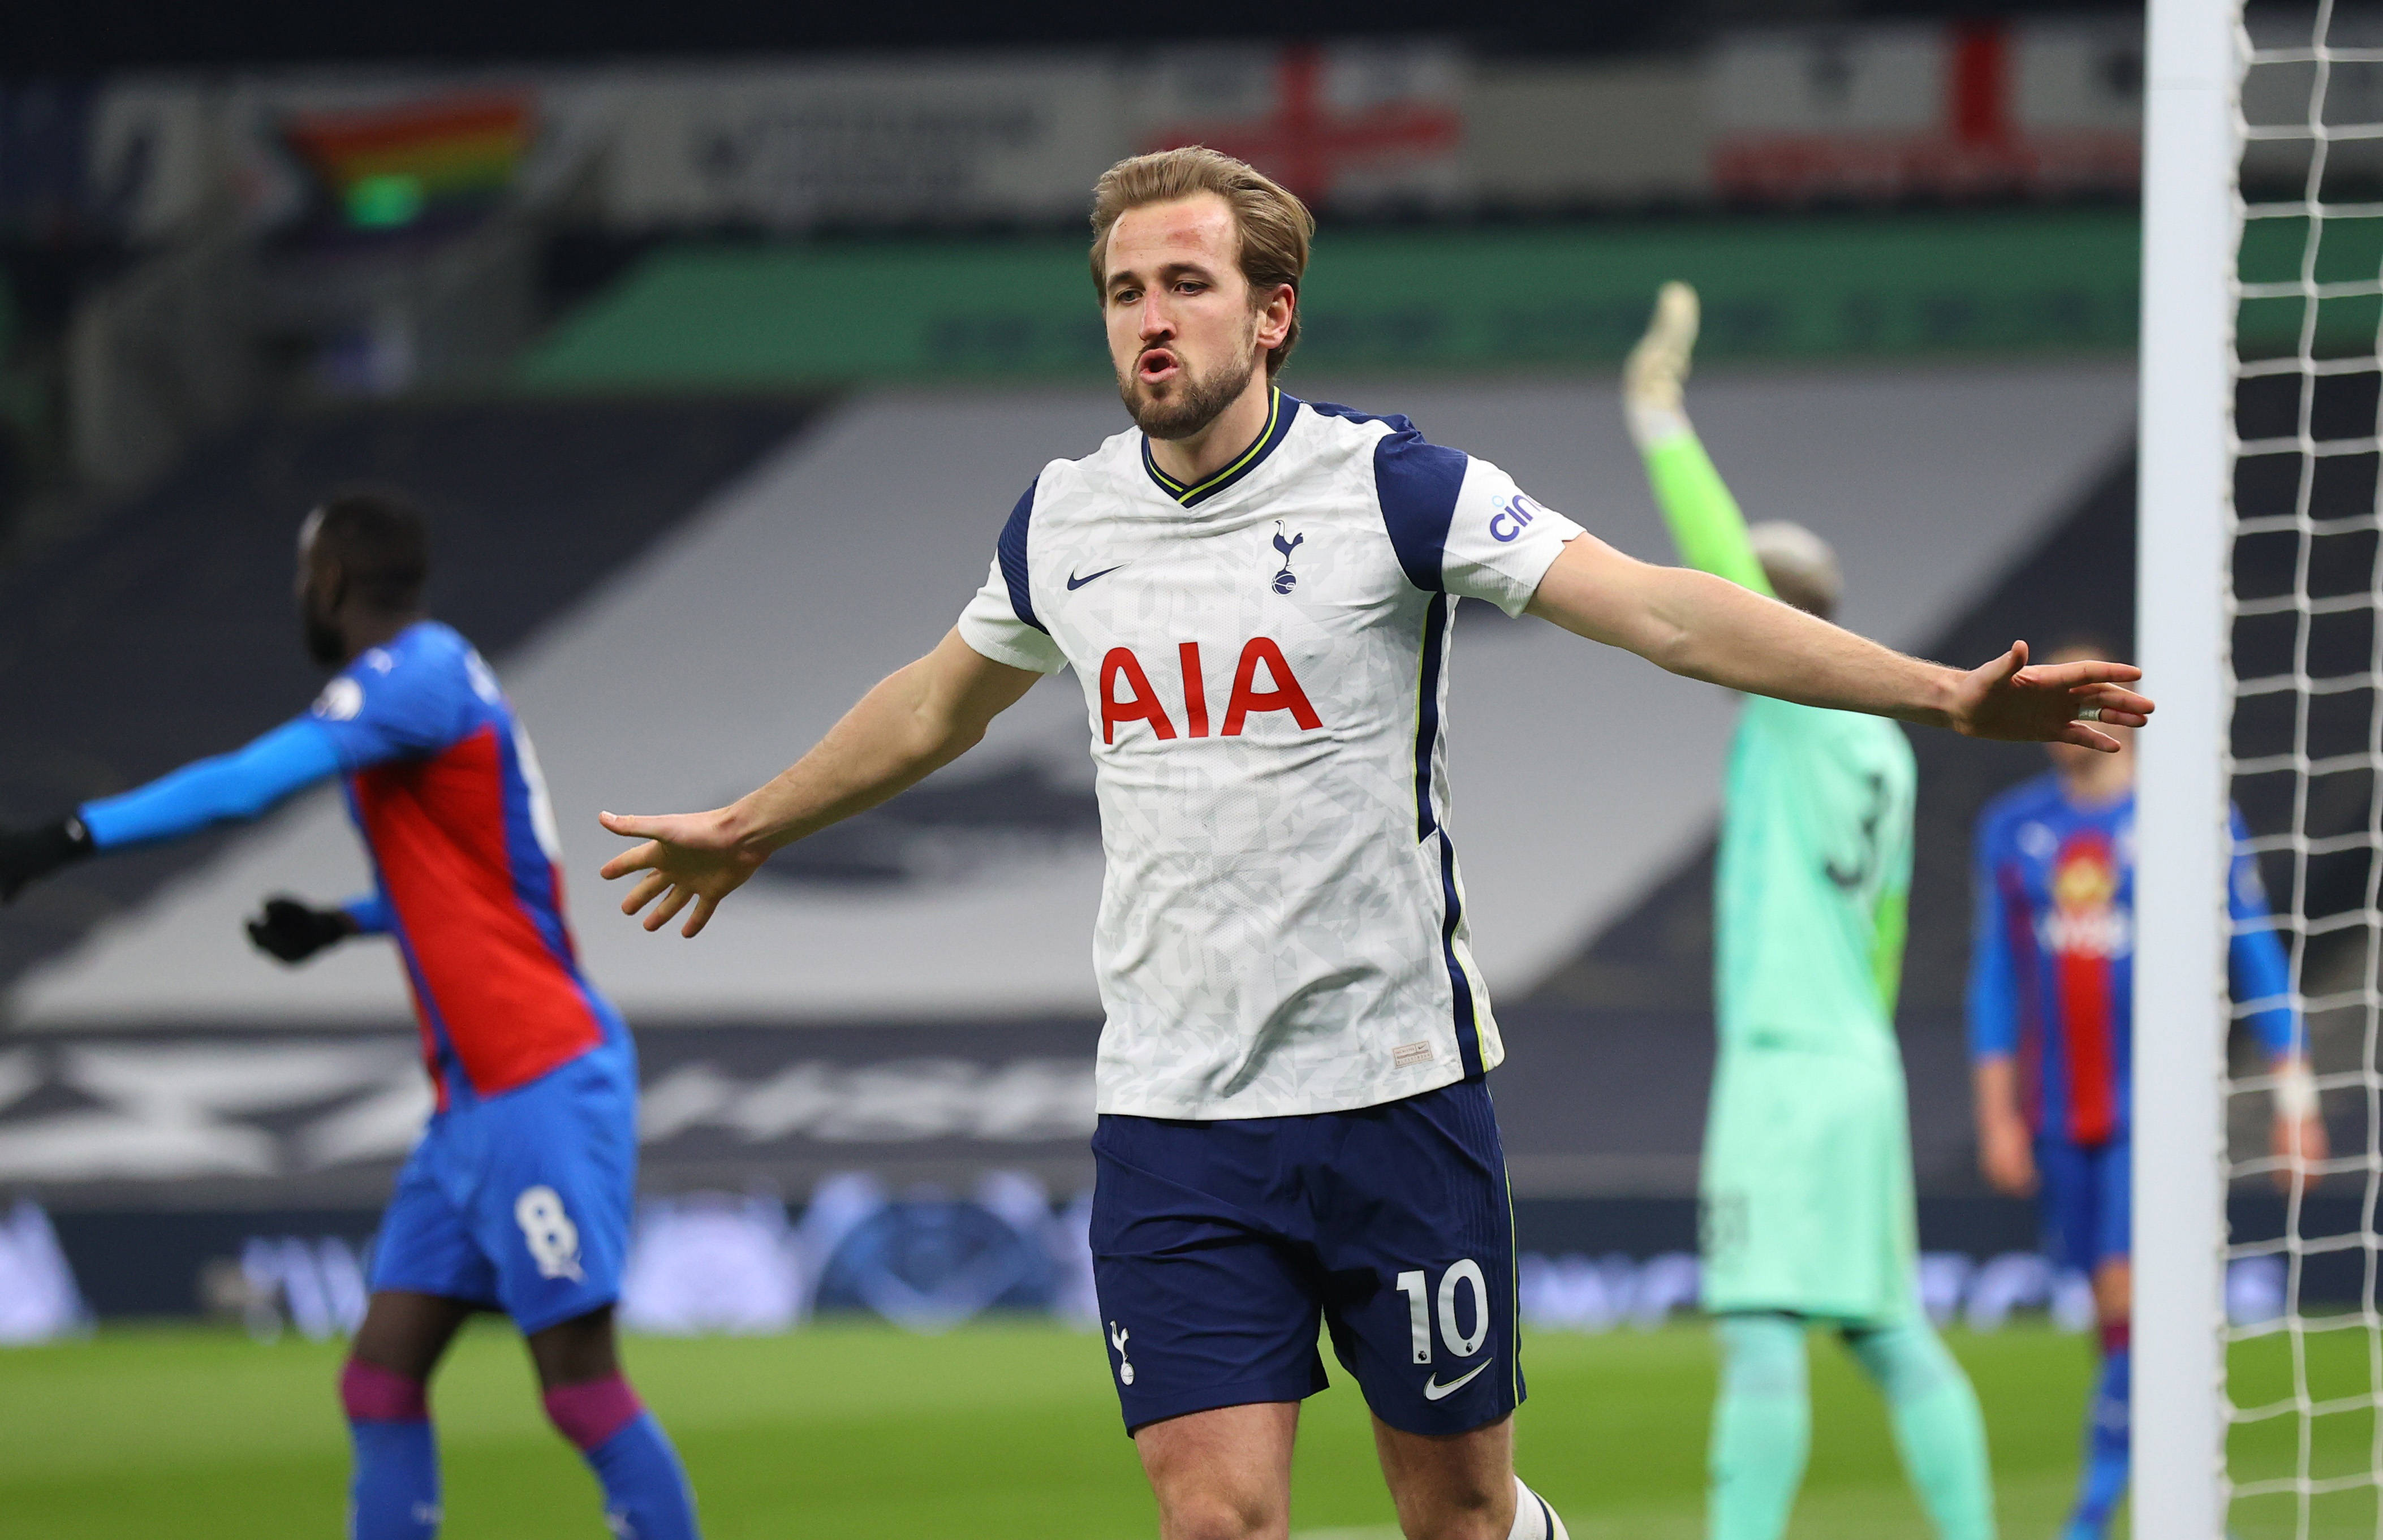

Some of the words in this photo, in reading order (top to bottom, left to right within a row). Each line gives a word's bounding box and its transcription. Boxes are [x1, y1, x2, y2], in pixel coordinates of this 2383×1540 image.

[1489, 494, 1546, 542] cin
[1099, 636, 1324, 745] AIA
[514, 1185, 580, 1265] 8
[1395, 1258, 1489, 1364] 10
